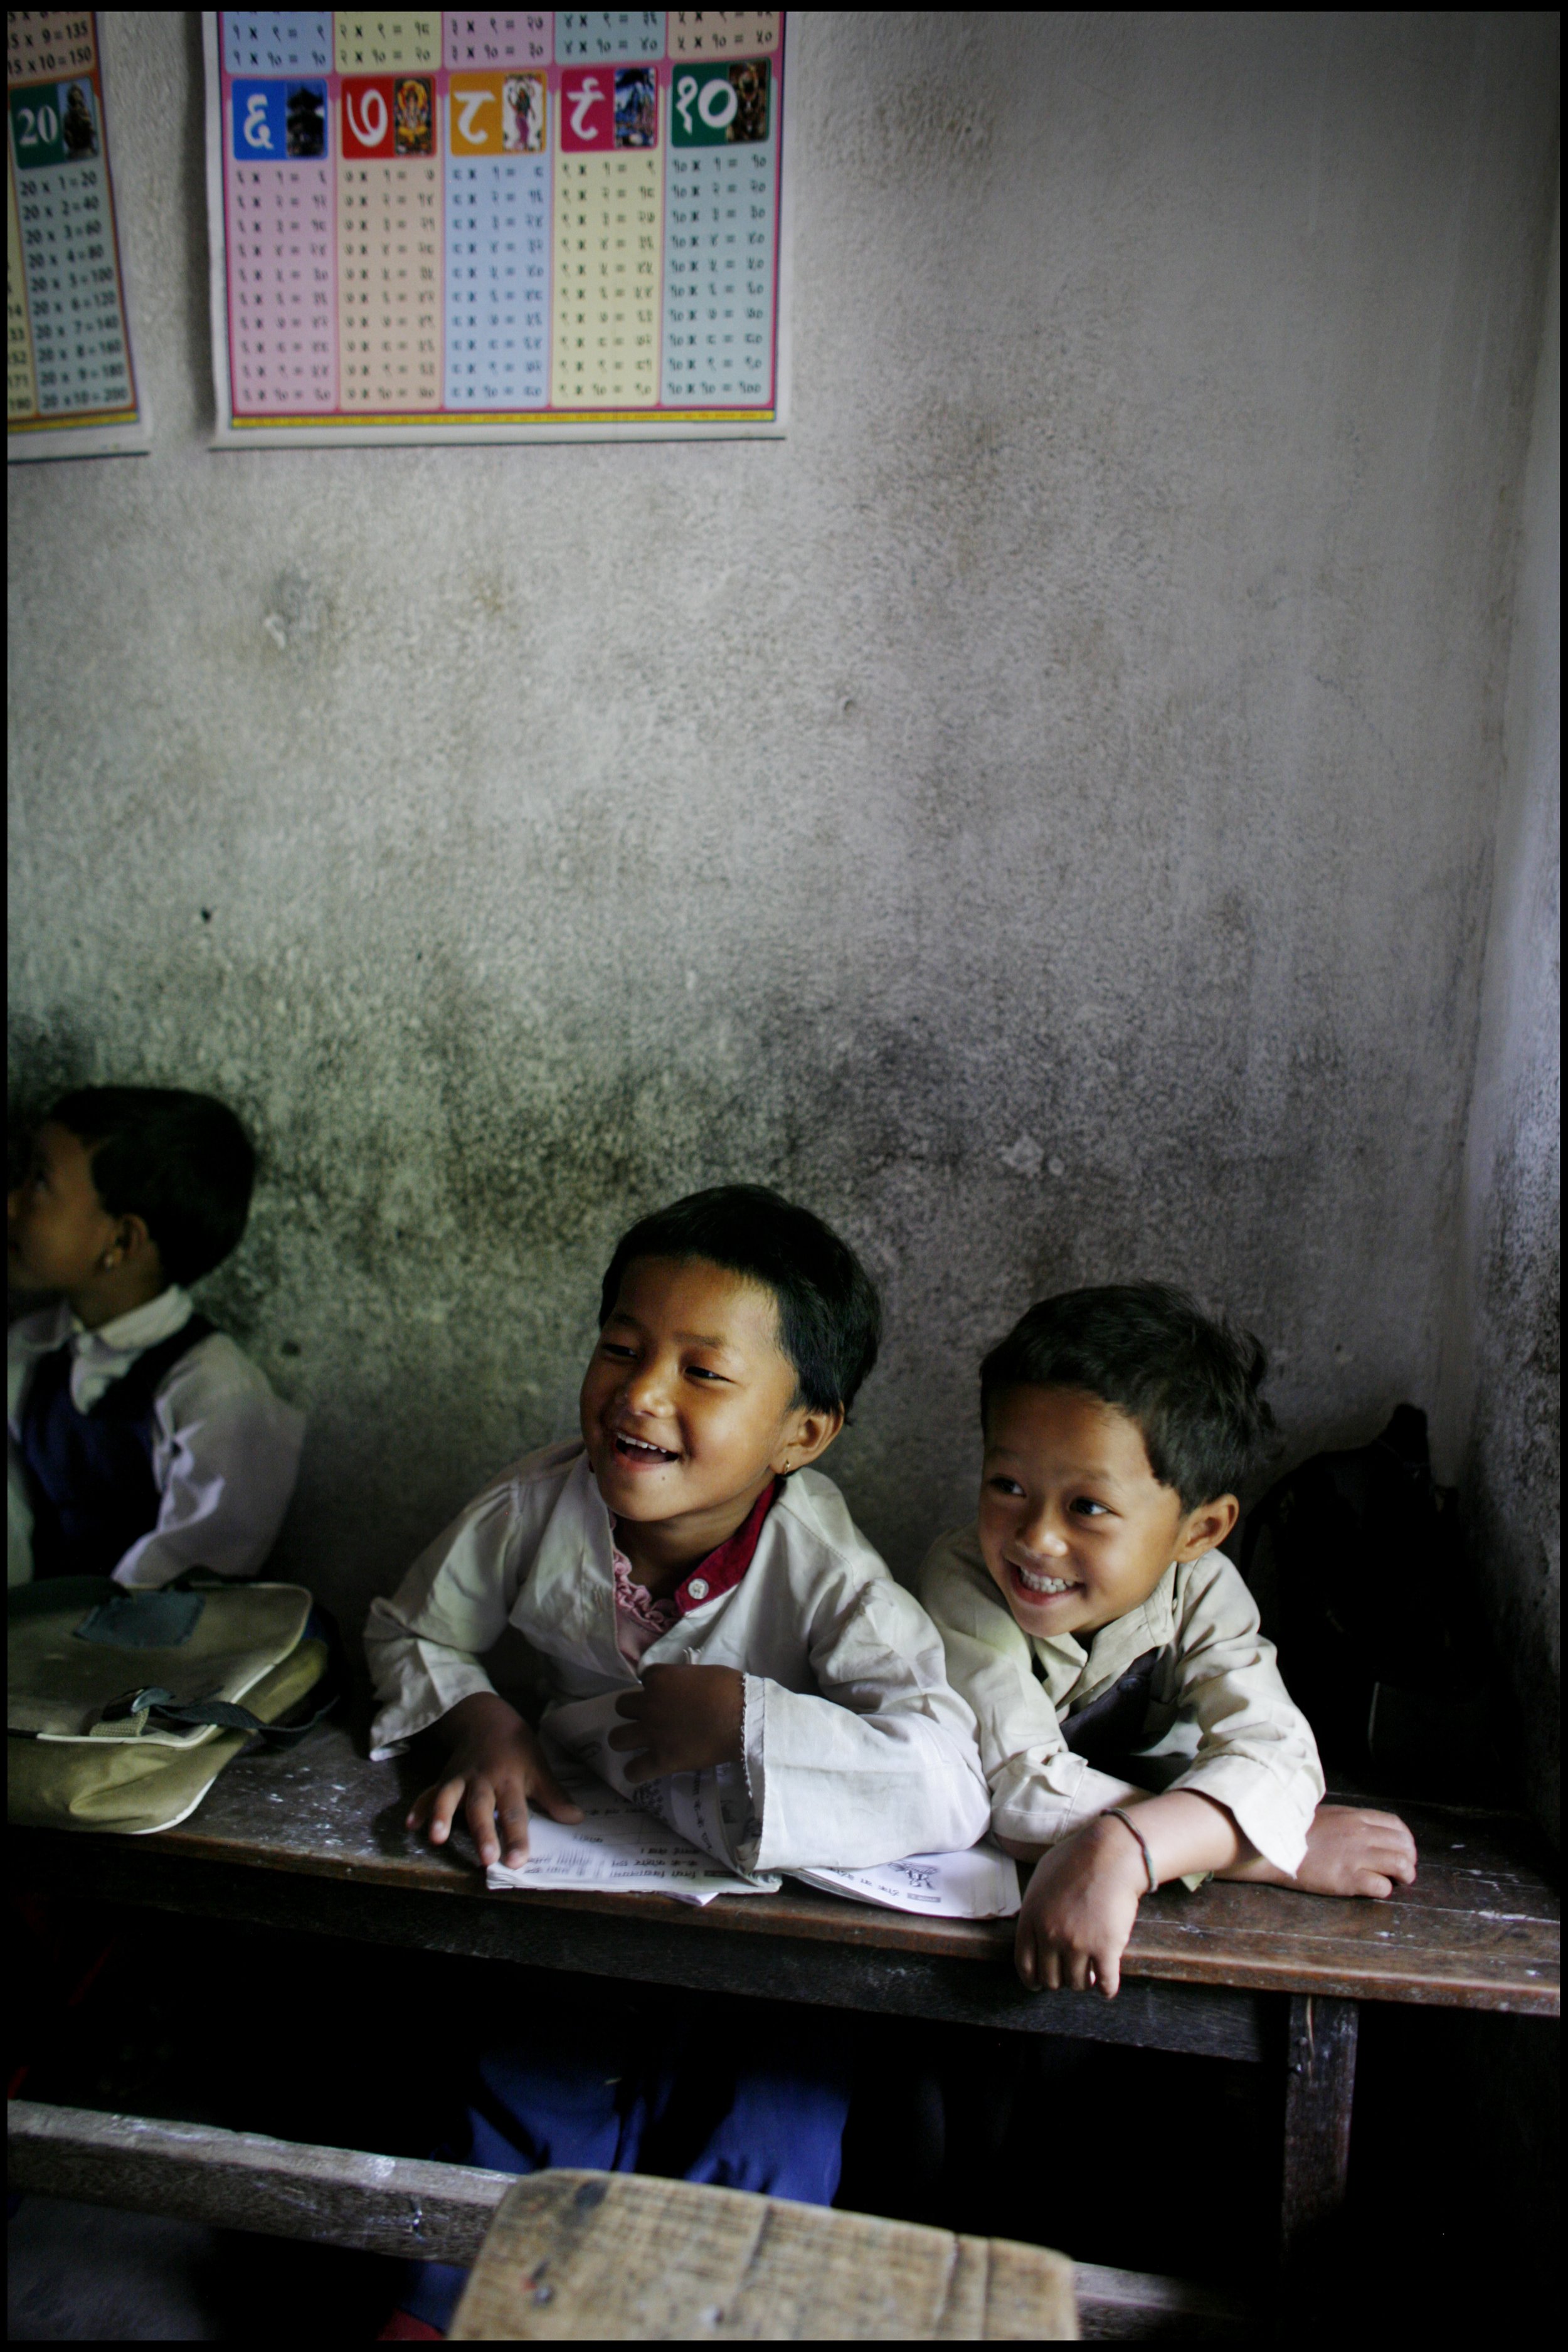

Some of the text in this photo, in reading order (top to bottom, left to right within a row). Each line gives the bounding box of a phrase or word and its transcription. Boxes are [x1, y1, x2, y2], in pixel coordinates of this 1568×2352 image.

[8, 33, 19, 50] 5
[596, 38, 613, 54] १०
[712, 33, 728, 49] १०
[267, 51, 283, 68] १०
[371, 47, 387, 63] १०
[484, 45, 499, 60] १०
[677, 76, 738, 134] १०
[18, 105, 58, 146] 20
[244, 93, 275, 150] ६
[346, 89, 388, 147] ७
[21, 181, 37, 196] 20
